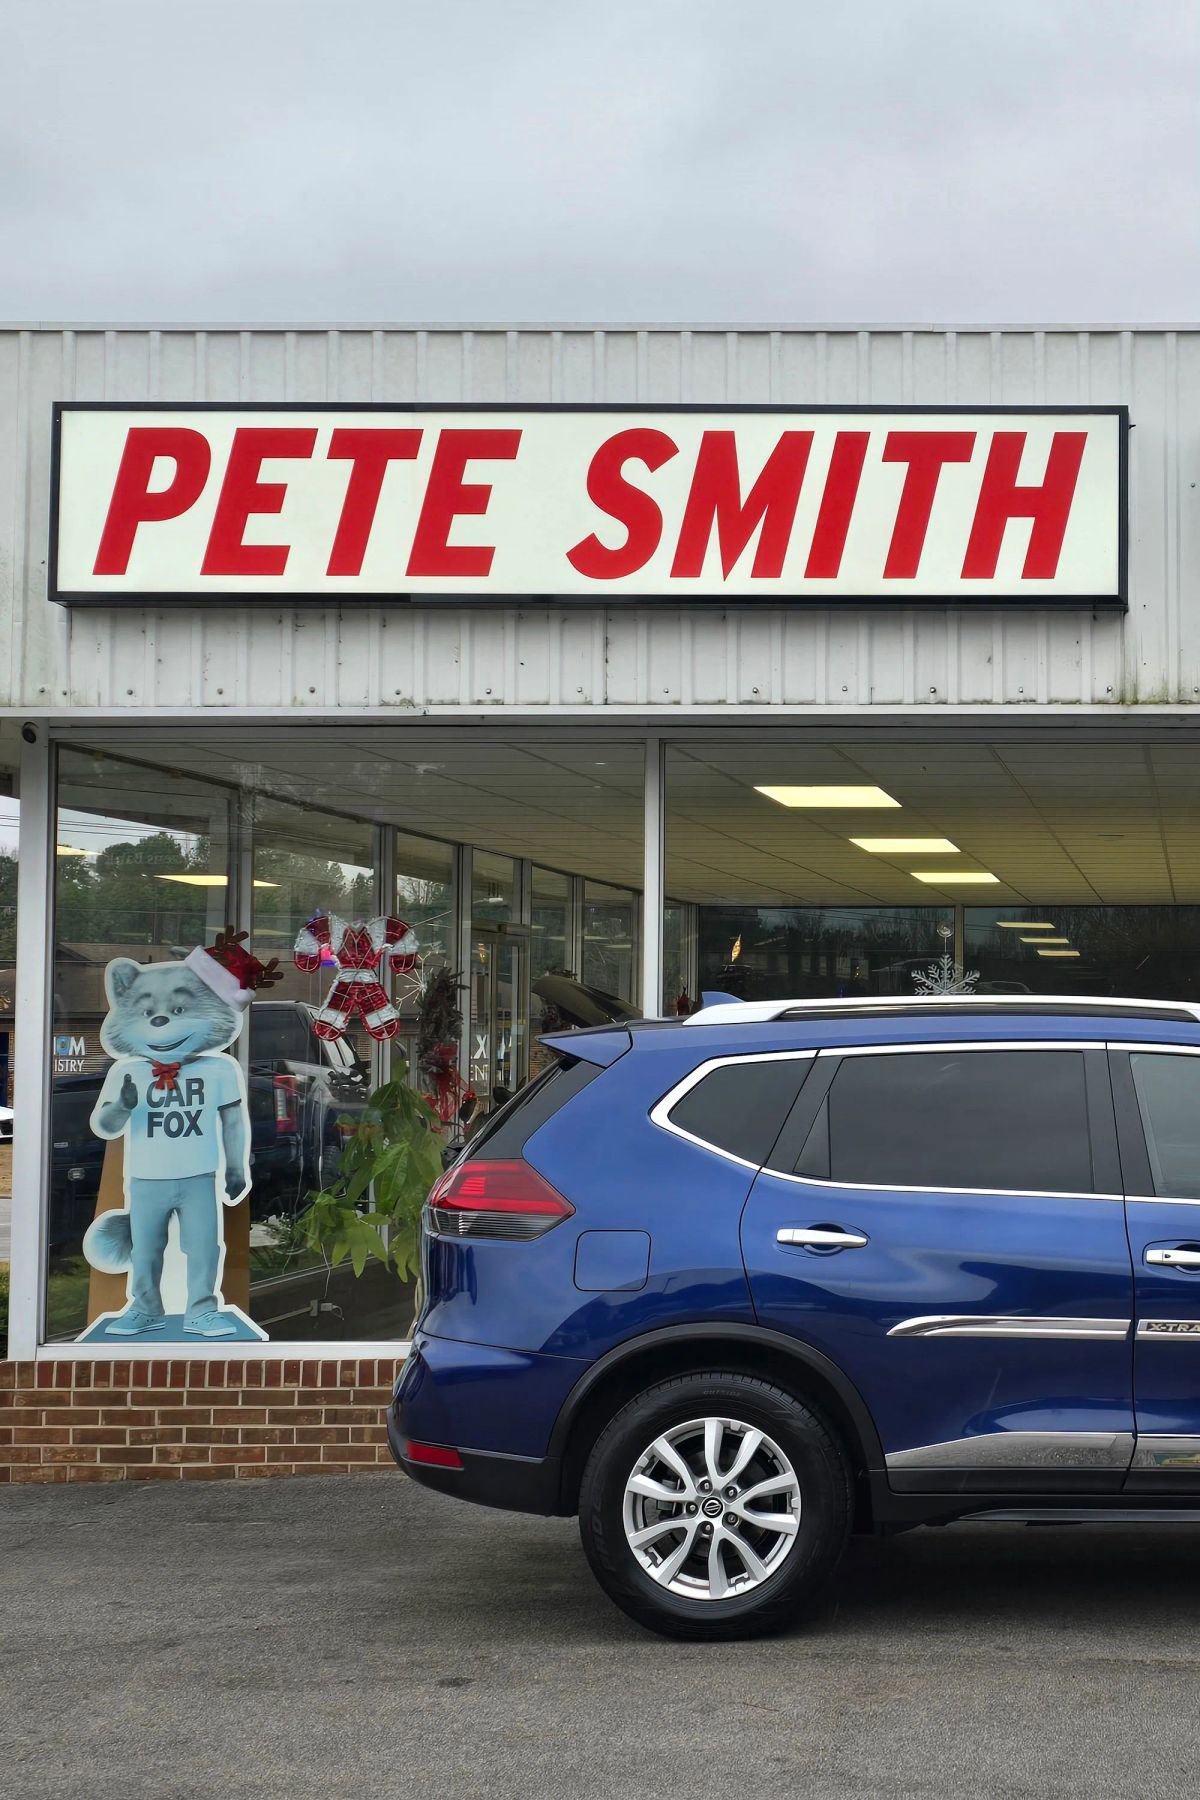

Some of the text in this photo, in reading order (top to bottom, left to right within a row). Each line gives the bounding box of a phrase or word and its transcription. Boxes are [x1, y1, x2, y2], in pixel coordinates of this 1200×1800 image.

[92, 427, 1087, 580] PETE SMITH
[146, 1077, 205, 1109] CAR
[147, 1109, 204, 1139] FOX
